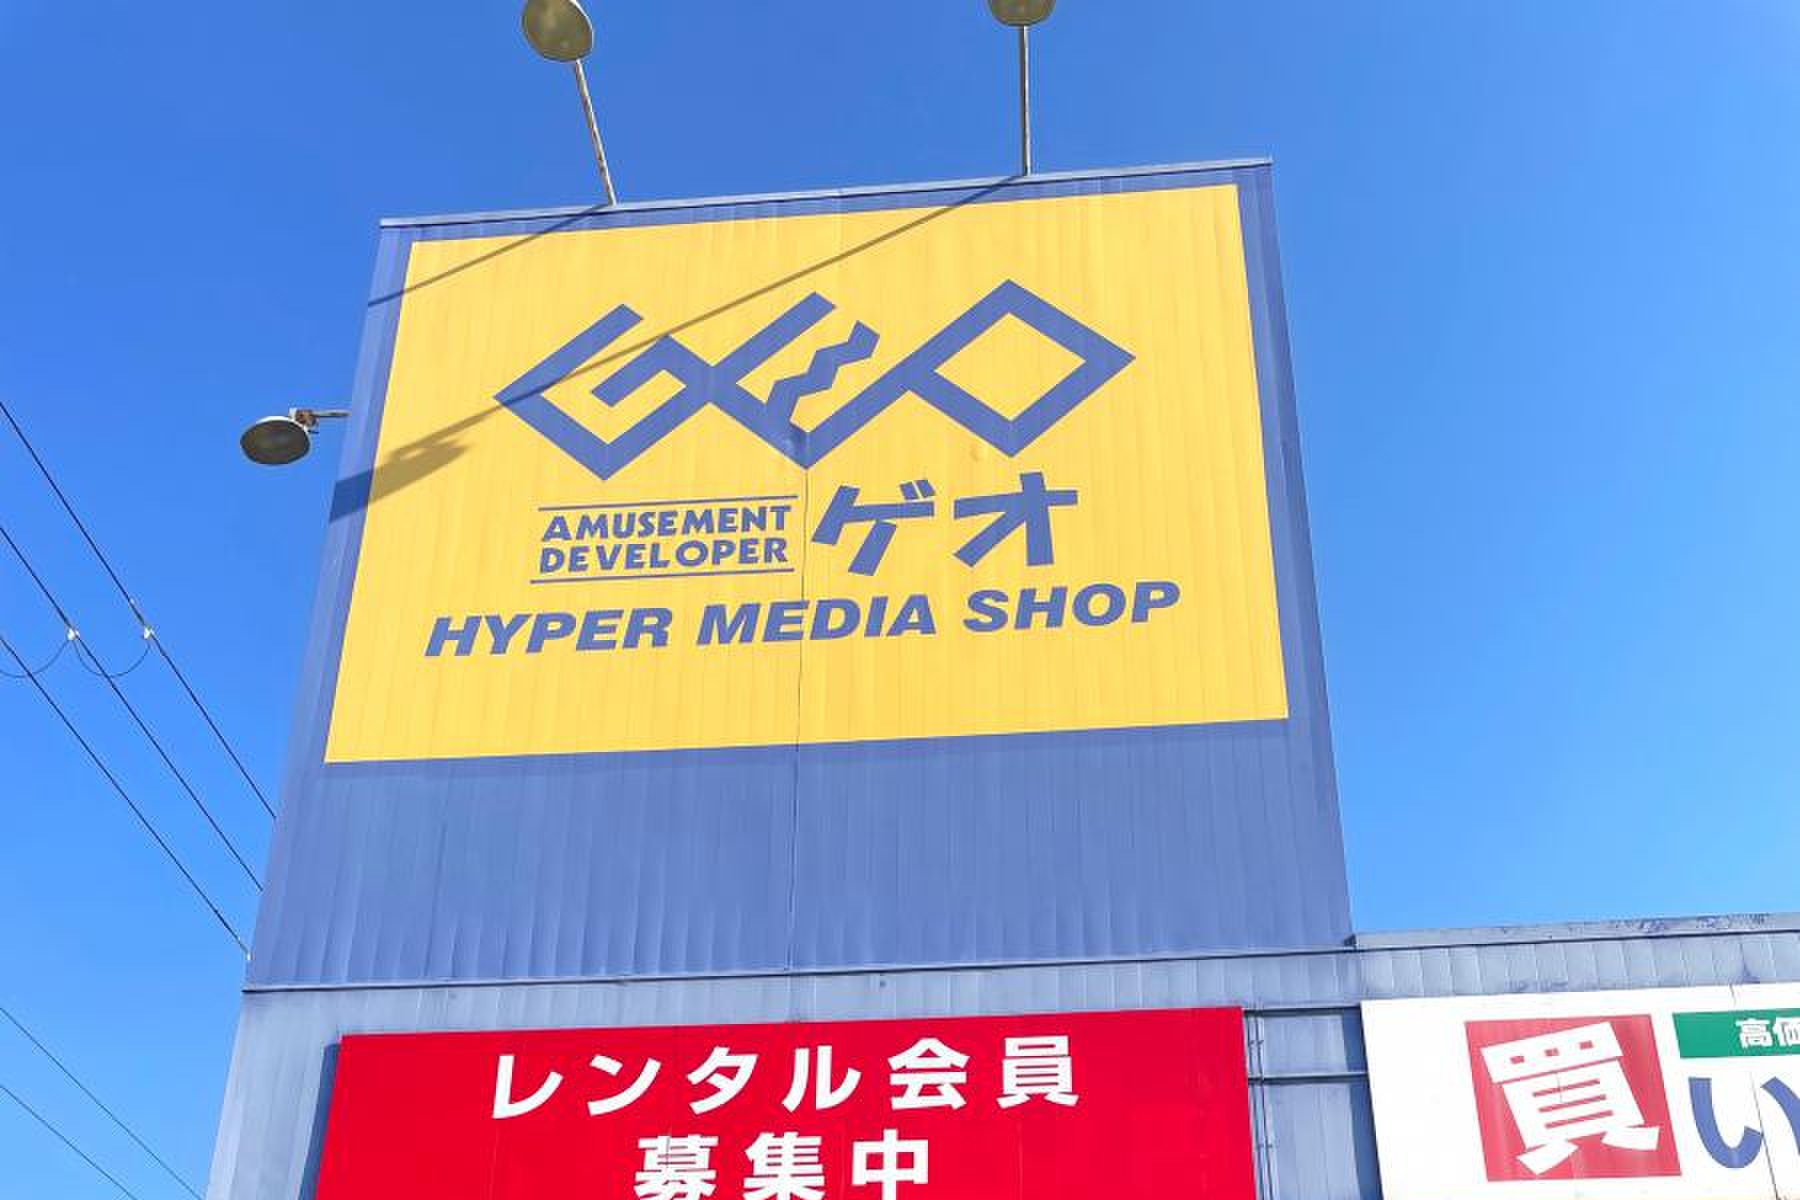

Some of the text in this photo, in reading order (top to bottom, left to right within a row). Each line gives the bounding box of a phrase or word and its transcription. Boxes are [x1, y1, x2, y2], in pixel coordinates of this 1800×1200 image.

[539, 536, 789, 573] DEVELOPER
[541, 505, 792, 541] AMUSEMENT
[811, 471, 1079, 575] ゲオ
[425, 581, 1181, 656] HYPER MEDIA SHOP
[491, 1034, 1080, 1119] レンタル会員
